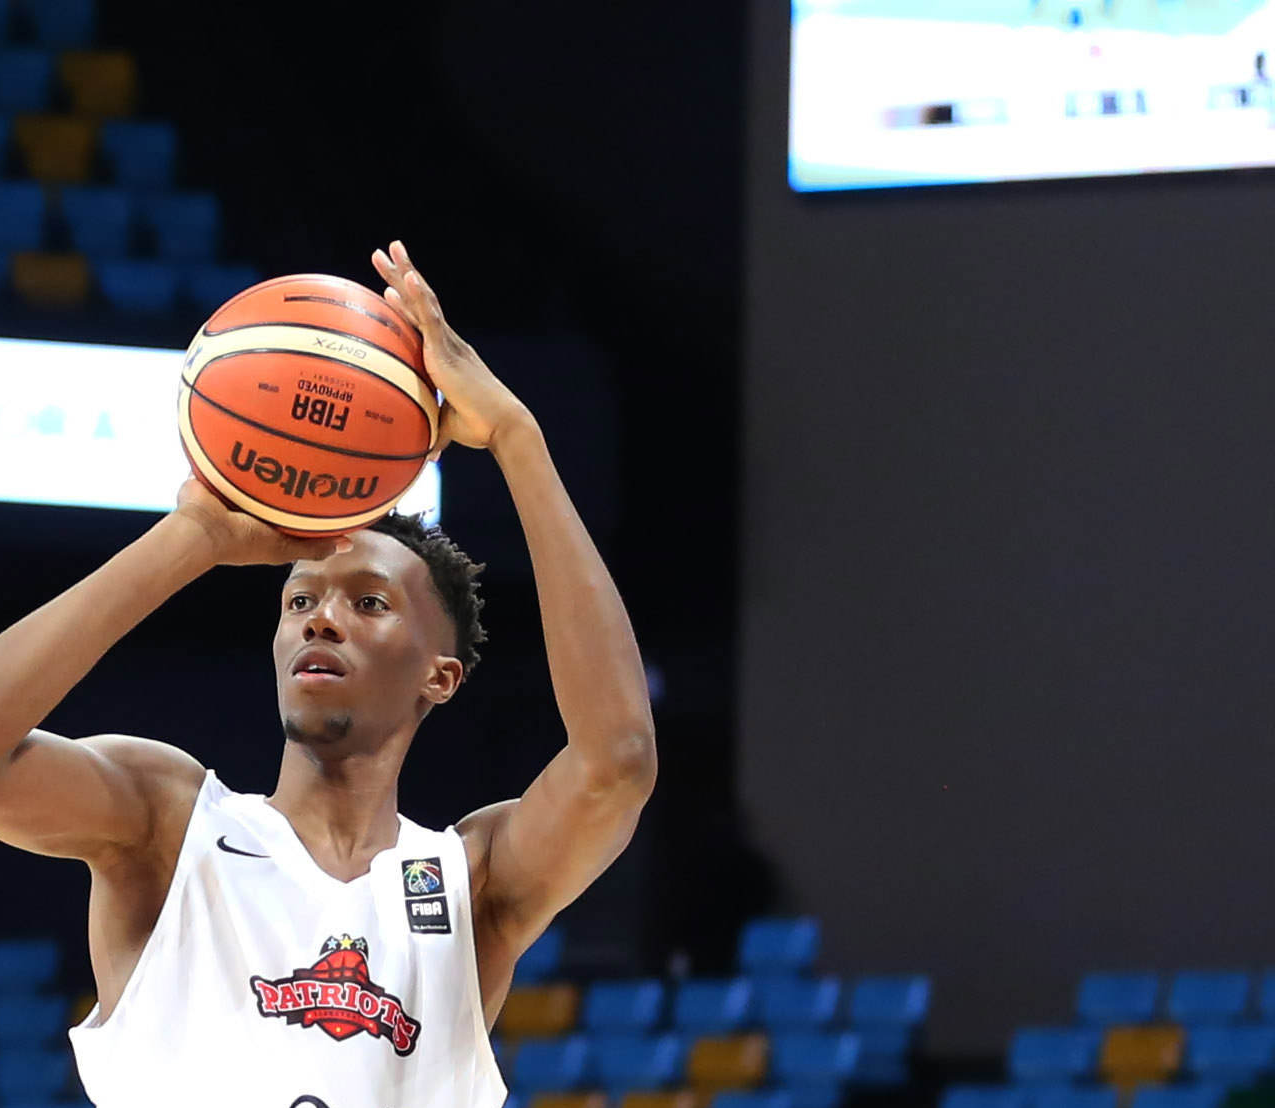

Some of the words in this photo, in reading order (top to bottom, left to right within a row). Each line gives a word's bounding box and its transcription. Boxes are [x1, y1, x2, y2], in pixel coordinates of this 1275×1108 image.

[298, 379, 353, 402] APPROVED
[292, 393, 350, 432] FIBA
[230, 441, 380, 498] molten
[411, 901, 443, 916] FIBA
[255, 980, 417, 1052] PATRIOTS
